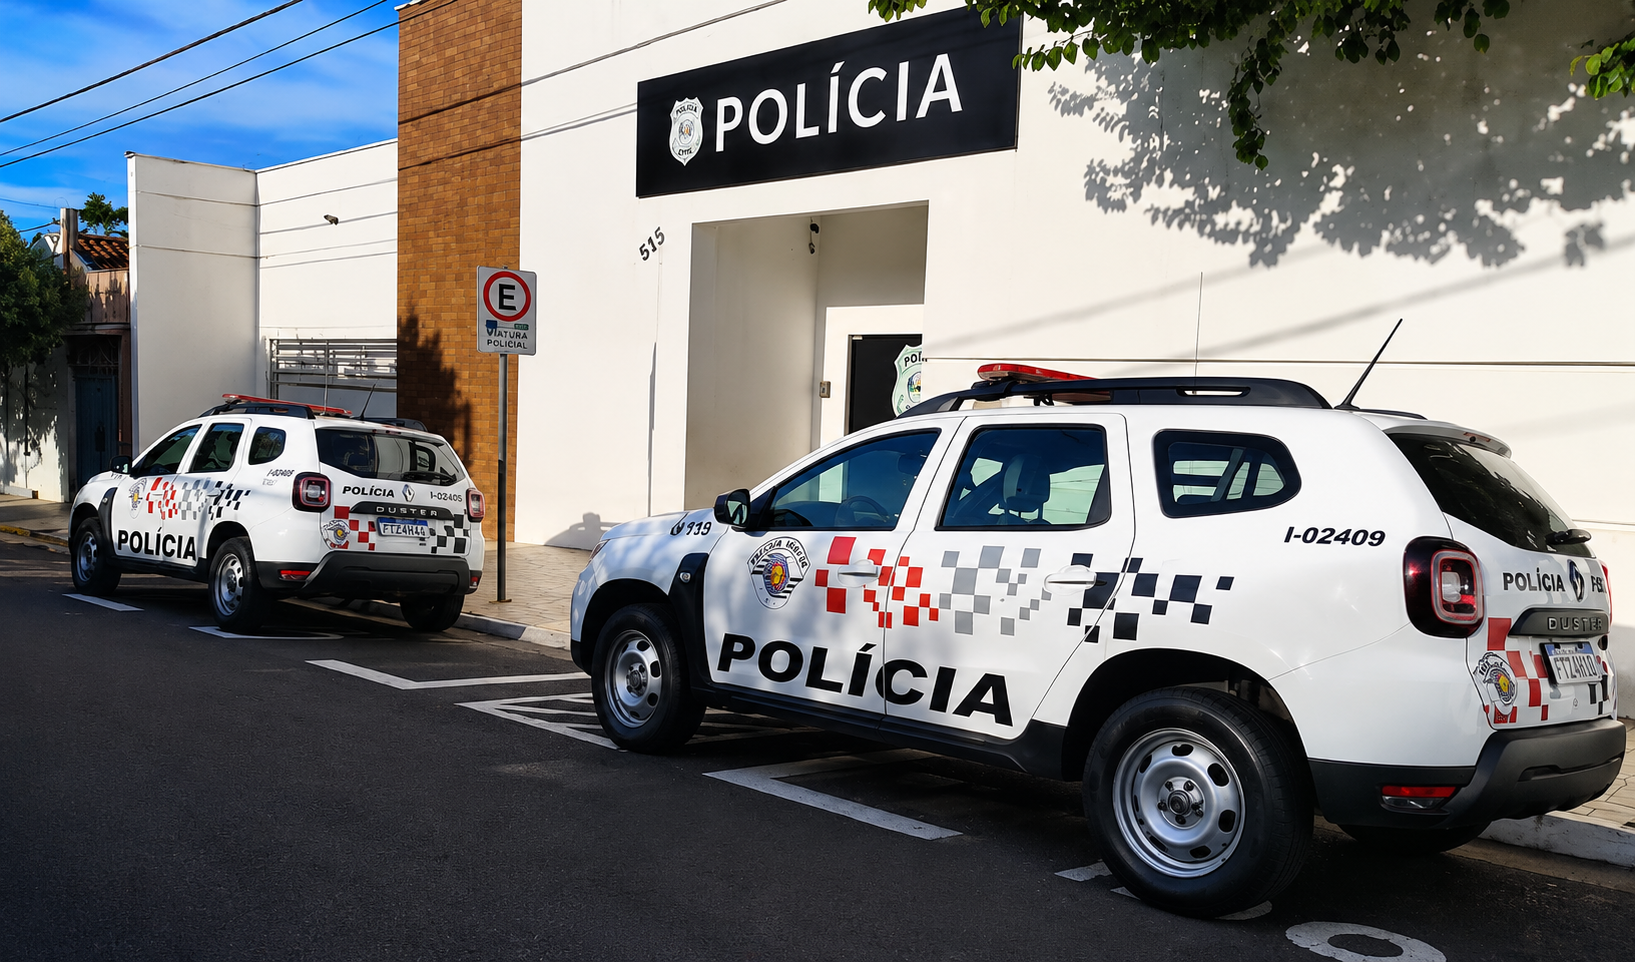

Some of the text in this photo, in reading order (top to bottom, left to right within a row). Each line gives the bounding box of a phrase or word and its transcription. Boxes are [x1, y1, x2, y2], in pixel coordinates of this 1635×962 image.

[715, 53, 963, 152] POLÍCIA
[639, 226, 665, 261] 515
[498, 283, 517, 311] E
[486, 328, 528, 340] VIATURA
[486, 338, 528, 350] POLICIAL
[342, 485, 395, 498] POLÍCIA
[376, 506, 438, 516] DUSTER
[117, 526, 197, 562] POLÍCIA
[1502, 567, 1566, 592] POLÍCIA
[1547, 616, 1602, 632] DUSTER
[717, 633, 1014, 728] POLÍCIA
